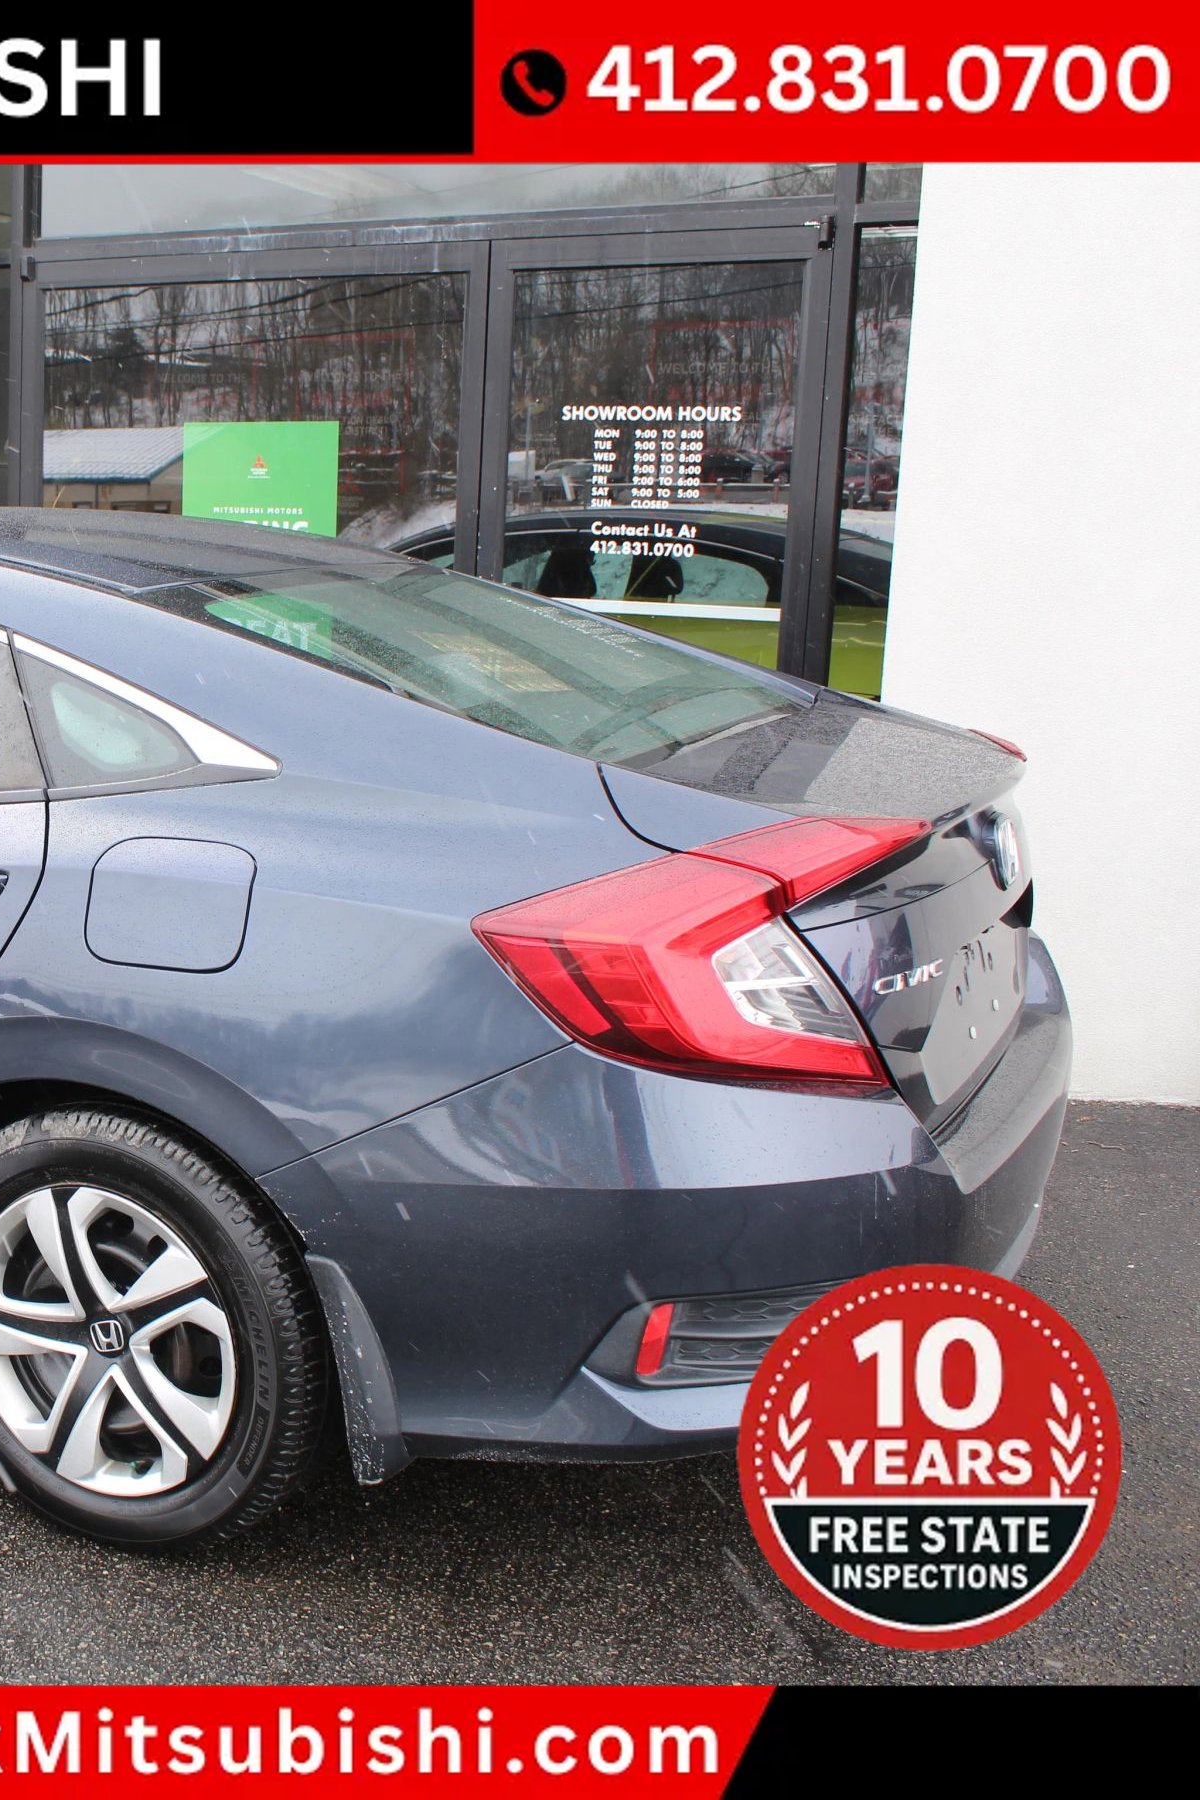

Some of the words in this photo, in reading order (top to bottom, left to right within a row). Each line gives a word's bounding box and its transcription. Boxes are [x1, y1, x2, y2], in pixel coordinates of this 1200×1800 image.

[561, 405, 673, 422] SHOWROOM
[678, 405, 742, 422] HOURS
[594, 429, 620, 438] MON
[635, 430, 657, 439] 9:00
[662, 430, 676, 439] TO
[680, 430, 704, 439] 8:00
[593, 441, 612, 450] TUE
[634, 441, 656, 451] 9:00
[661, 441, 675, 451] TO
[679, 442, 703, 451] 8:00
[593, 452, 617, 462] WED
[634, 453, 656, 462] 9:00
[660, 453, 674, 463] TO
[678, 453, 702, 463] 8:00
[593, 464, 613, 473] THU
[633, 464, 655, 474] 9:00
[660, 465, 674, 474] TO
[678, 465, 702, 475] 8:00
[592, 476, 608, 485] FRI
[632, 476, 654, 486] 9:00
[659, 477, 673, 486] TO
[677, 477, 700, 487] 6:00
[591, 487, 609, 497] SAT
[631, 488, 653, 498] 9:00
[657, 488, 671, 498] TO
[677, 489, 700, 498] 5:00
[591, 499, 611, 508] SUN
[631, 500, 669, 509] CLOSED
[213, 507, 264, 515] MITSUBISHI
[267, 507, 303, 515] MOTORS
[590, 521, 649, 537] Contact
[653, 523, 674, 538] Us
[677, 523, 697, 538] At
[590, 540, 695, 557] 412.831.0700
[873, 957, 945, 995] CIVIC
[232, 1276, 270, 1401] MICHELIN
[243, 1416, 264, 1467] DEFENDER
